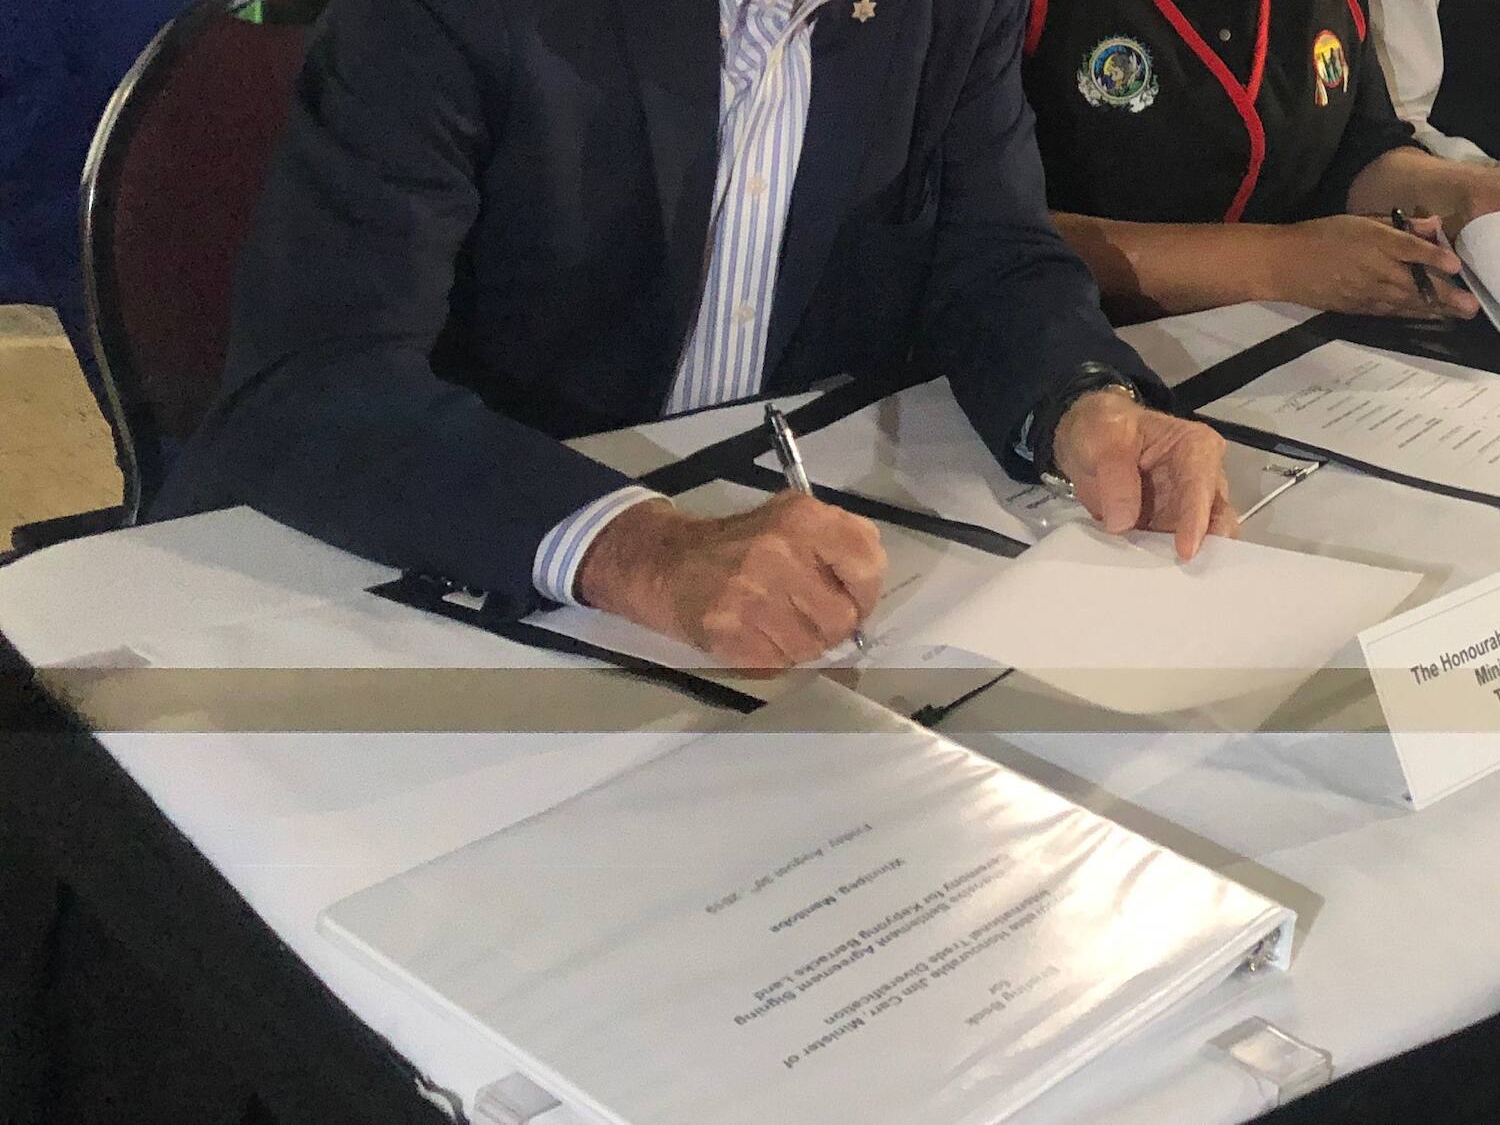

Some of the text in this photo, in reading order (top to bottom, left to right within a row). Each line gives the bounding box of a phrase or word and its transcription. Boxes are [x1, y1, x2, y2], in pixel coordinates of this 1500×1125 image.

[1410, 663, 1439, 685] The
[923, 890, 945, 904] for
[858, 902, 924, 940] Kapyong
[875, 902, 951, 947] Settlement
[794, 938, 862, 976] Barracks
[796, 945, 875, 992] Agreement
[823, 888, 1051, 1025] International Trade Diversification
[928, 931, 1010, 978] Honourable
[753, 975, 794, 1002] Land
[901, 977, 929, 996] Jim
[734, 990, 797, 1026] Signing
[862, 995, 903, 1017] Carr,
[803, 1017, 865, 1056] Minister
[783, 1055, 800, 1069] of
